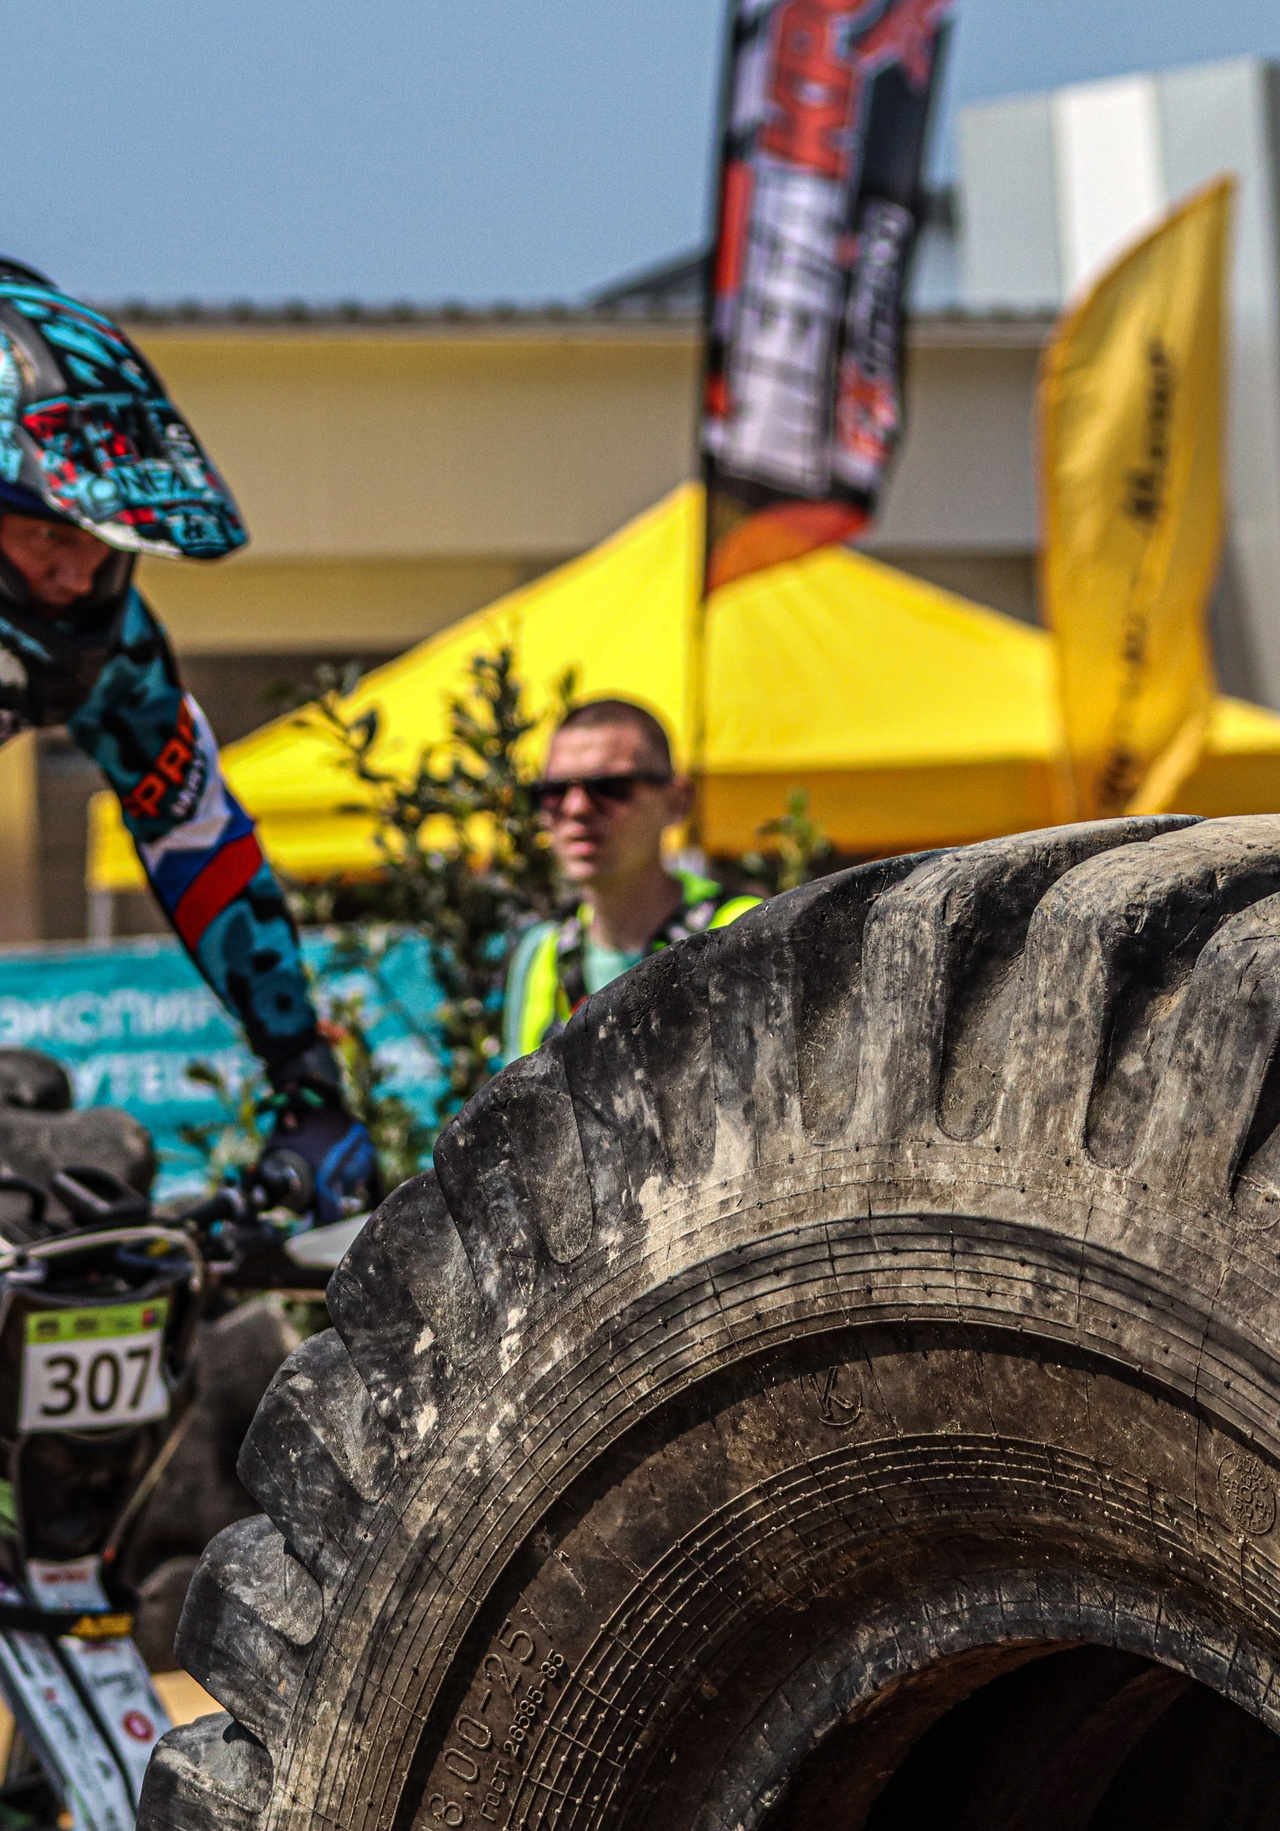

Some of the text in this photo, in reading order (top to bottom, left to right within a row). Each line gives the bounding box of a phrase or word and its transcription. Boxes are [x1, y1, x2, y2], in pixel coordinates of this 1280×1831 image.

[39, 1347, 153, 1417] 307
[479, 1649, 566, 1822] ГОСТ 26585-85
